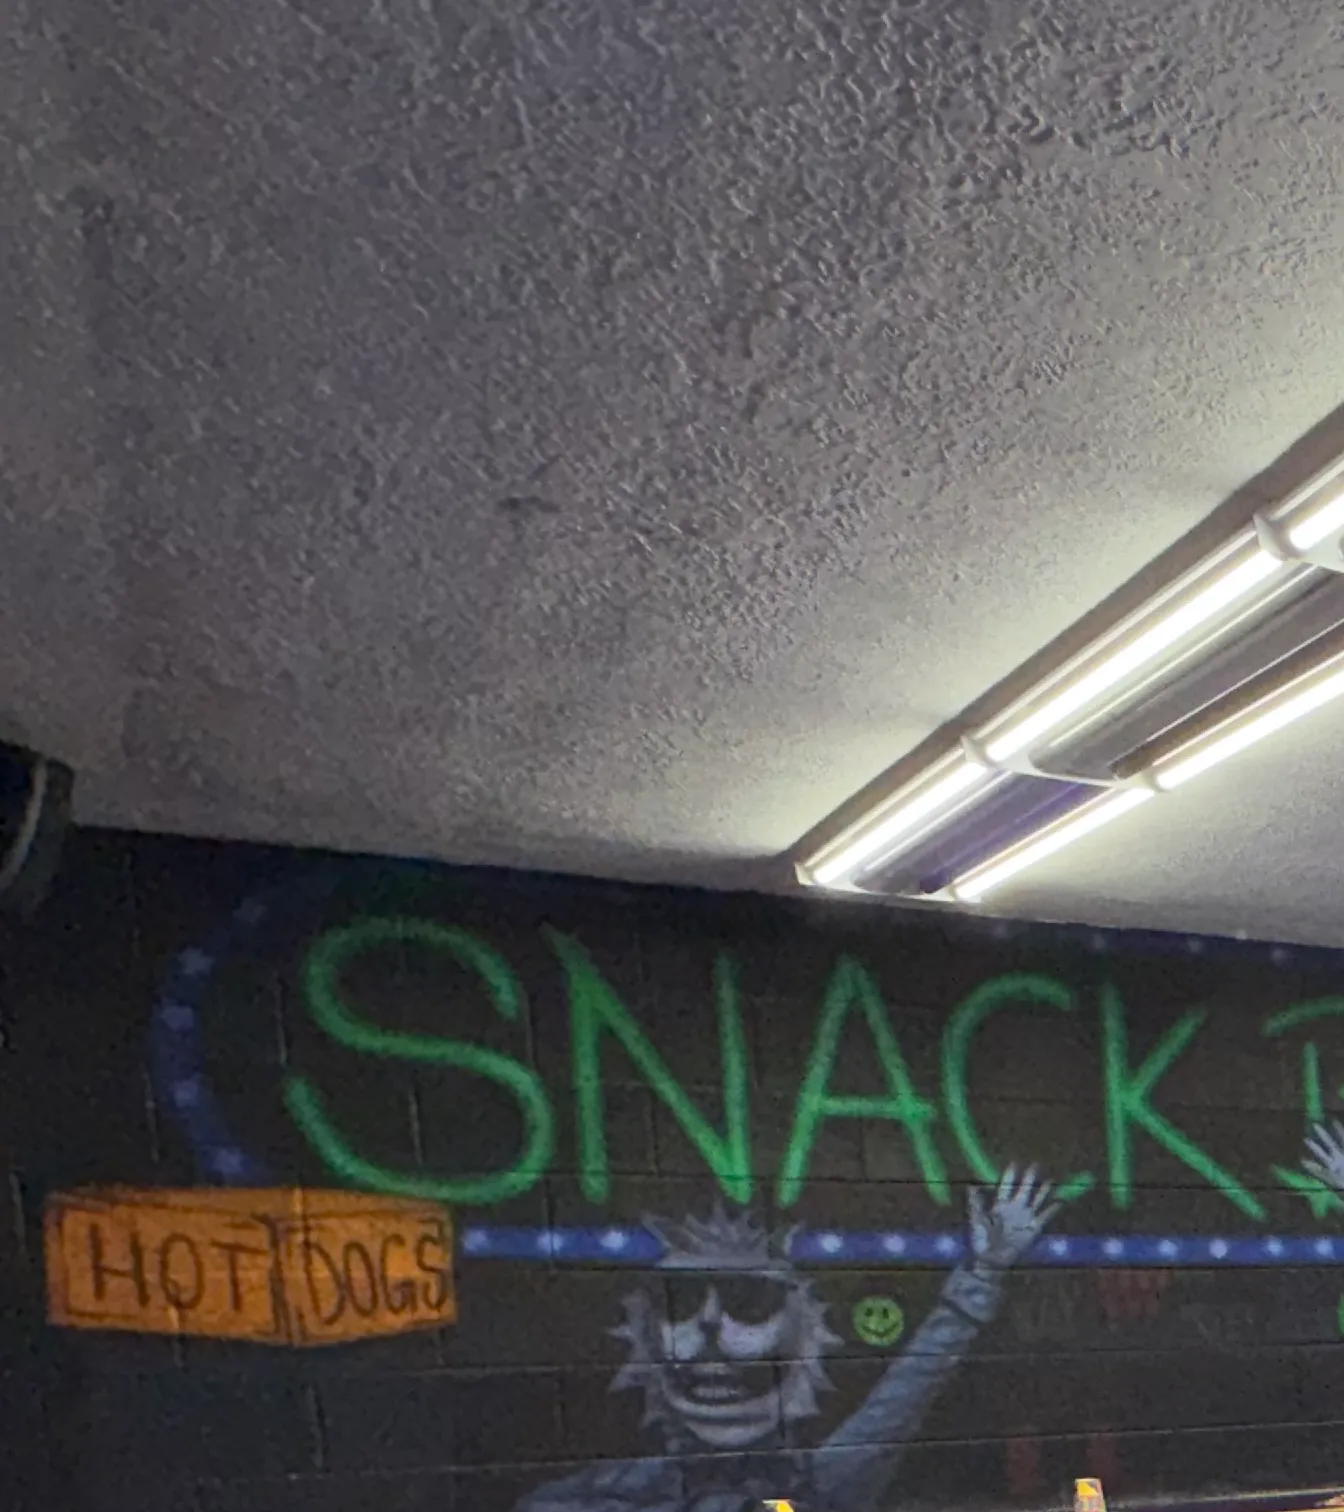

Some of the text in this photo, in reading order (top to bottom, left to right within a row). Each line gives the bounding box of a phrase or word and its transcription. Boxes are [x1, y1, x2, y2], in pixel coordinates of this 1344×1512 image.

[282, 915, 1267, 1219] SNACK
[88, 1217, 450, 1326] HOT DOGS
